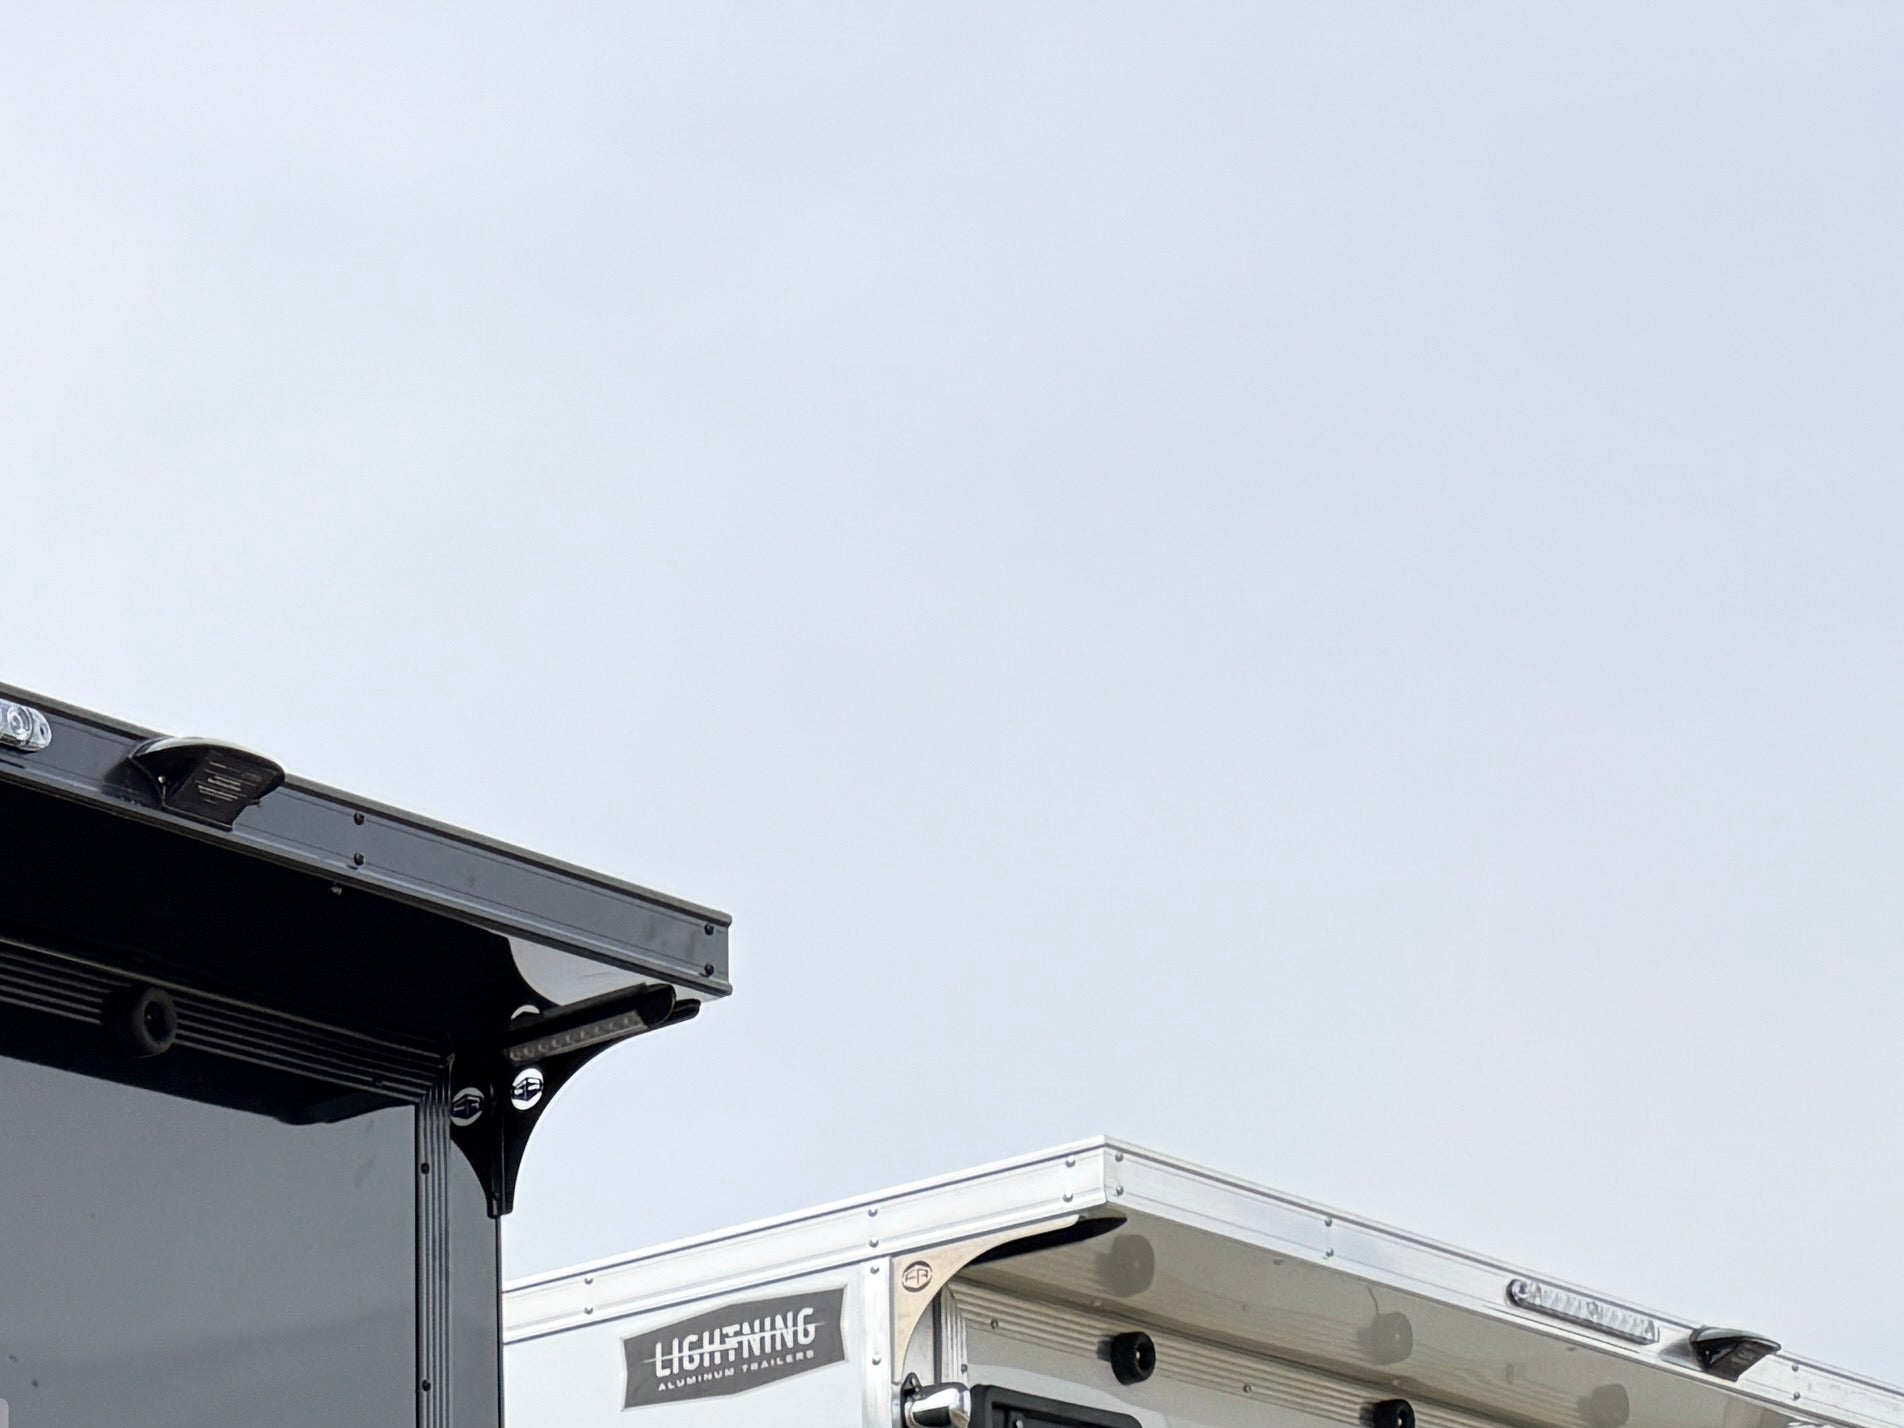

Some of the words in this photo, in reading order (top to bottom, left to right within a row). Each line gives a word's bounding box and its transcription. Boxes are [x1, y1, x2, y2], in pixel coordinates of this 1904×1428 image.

[654, 1306, 817, 1379] LIGHTNING
[658, 1367, 735, 1391] ALUMINUM
[742, 1349, 815, 1373] TRAILERS
